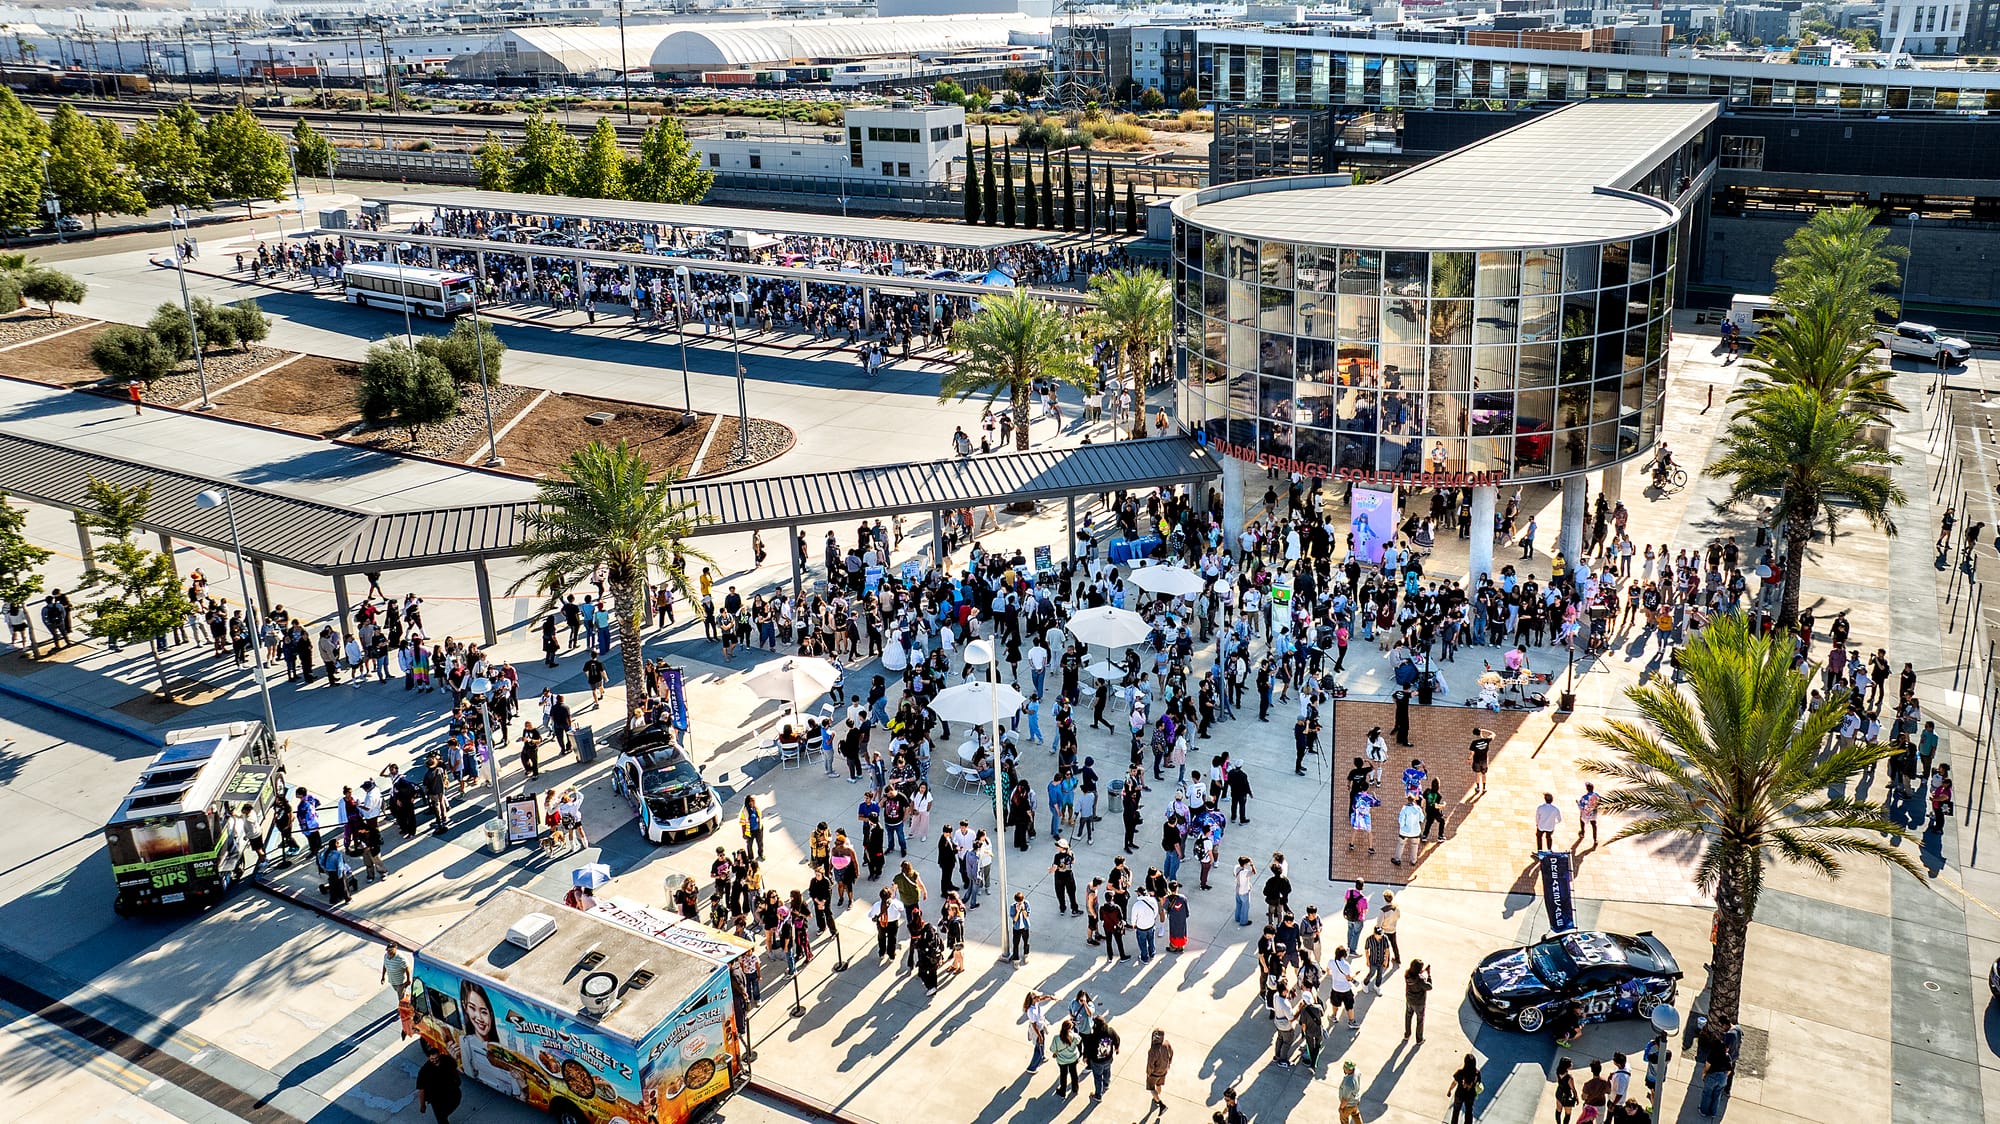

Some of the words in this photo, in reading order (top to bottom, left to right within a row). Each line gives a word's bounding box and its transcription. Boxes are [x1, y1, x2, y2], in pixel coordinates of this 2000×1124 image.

[1213, 437, 1257, 464] WARM
[1260, 453, 1328, 479] SPRINGS
[1331, 465, 1337, 480] /
[1339, 467, 1403, 486] SOUTH
[1411, 471, 1505, 488] FREMONT
[236, 772, 267, 793] SIPS
[1196, 788, 1202, 799] 5
[150, 864, 186, 876] CREATIVE
[193, 860, 214, 869] BOBA
[151, 870, 188, 888] SIPS
[1550, 857, 1564, 927] DREAMSCAPE
[509, 1015, 558, 1039] SAIGON
[570, 1032, 619, 1070] STREET
[619, 1062, 634, 1081] 2
[650, 1022, 686, 1060] SAIGON
